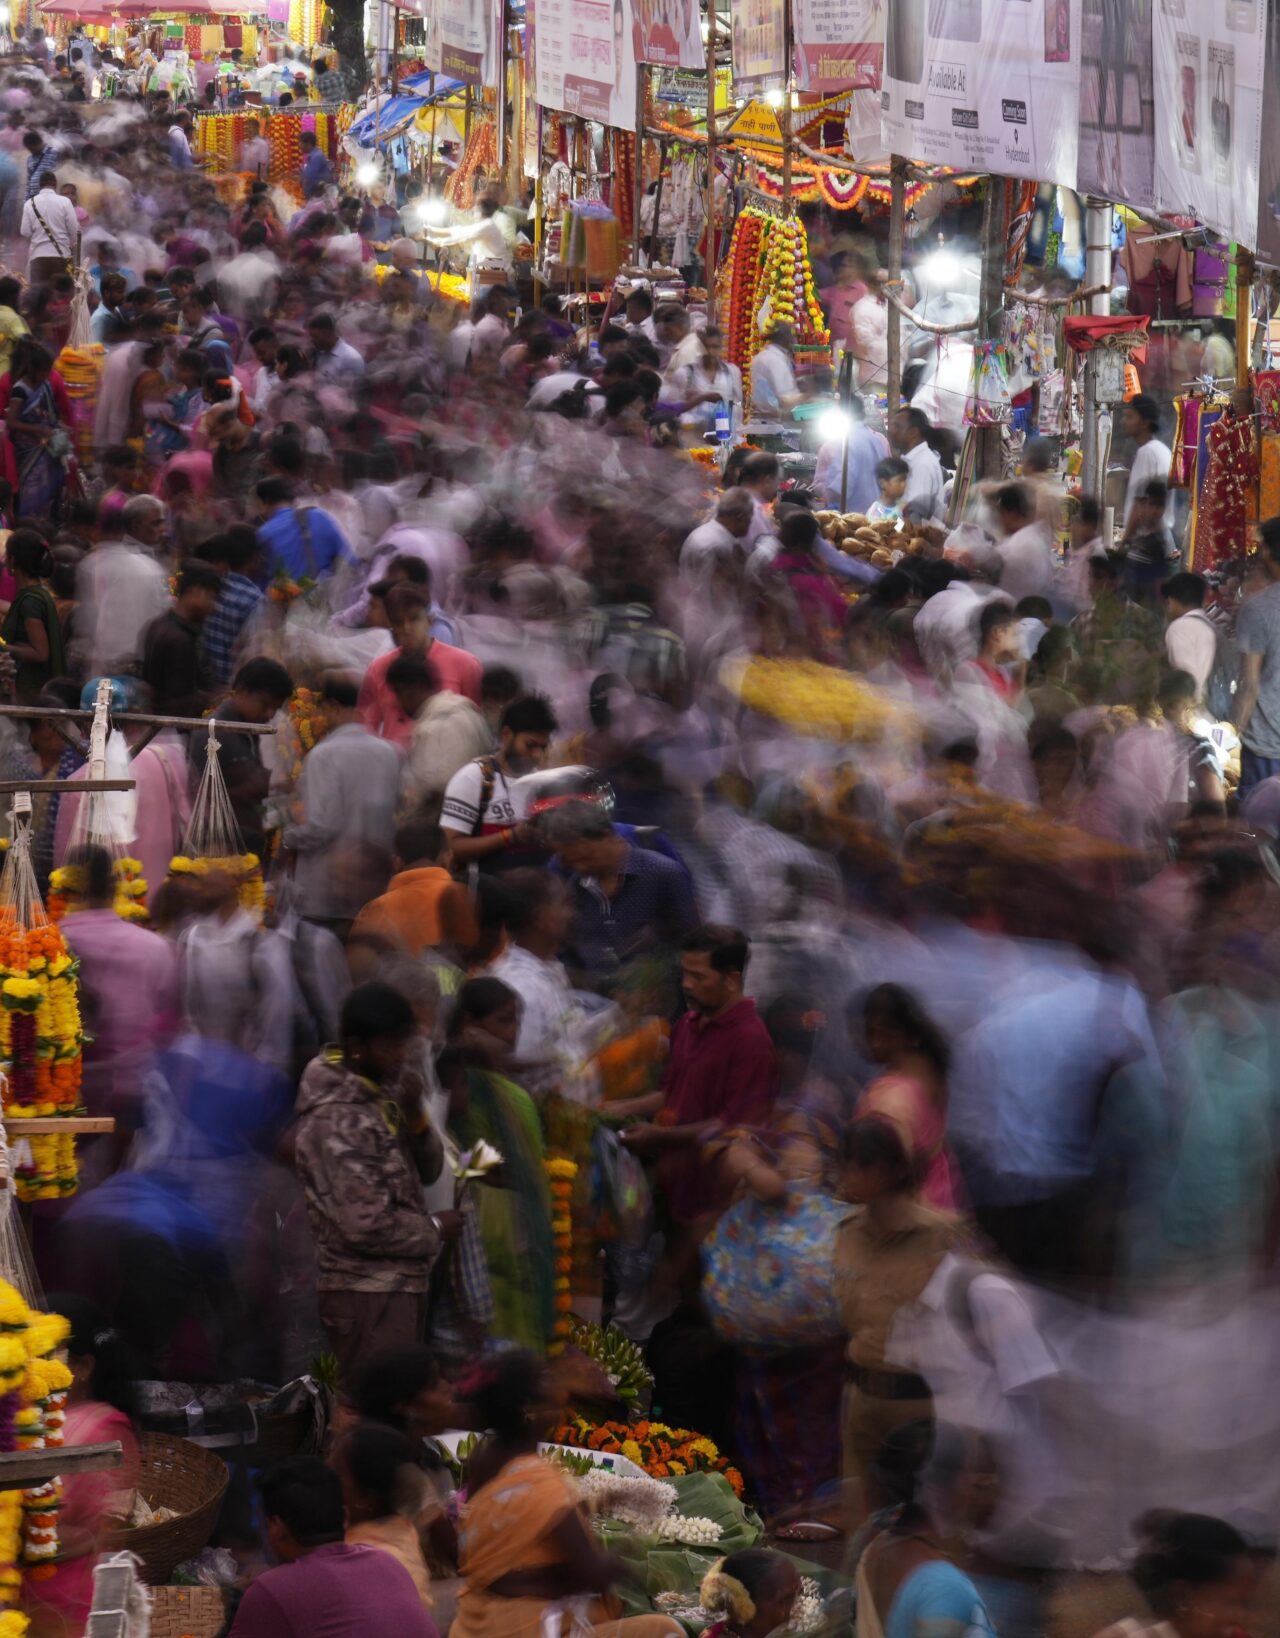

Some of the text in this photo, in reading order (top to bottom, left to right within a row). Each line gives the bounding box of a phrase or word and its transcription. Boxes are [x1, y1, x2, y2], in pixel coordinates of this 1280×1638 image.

[928, 65, 966, 92] Available At
[1003, 102, 1025, 118] Coming Soon
[739, 119, 756, 129] नाही
[1005, 146, 1030, 164] Hyderabad
